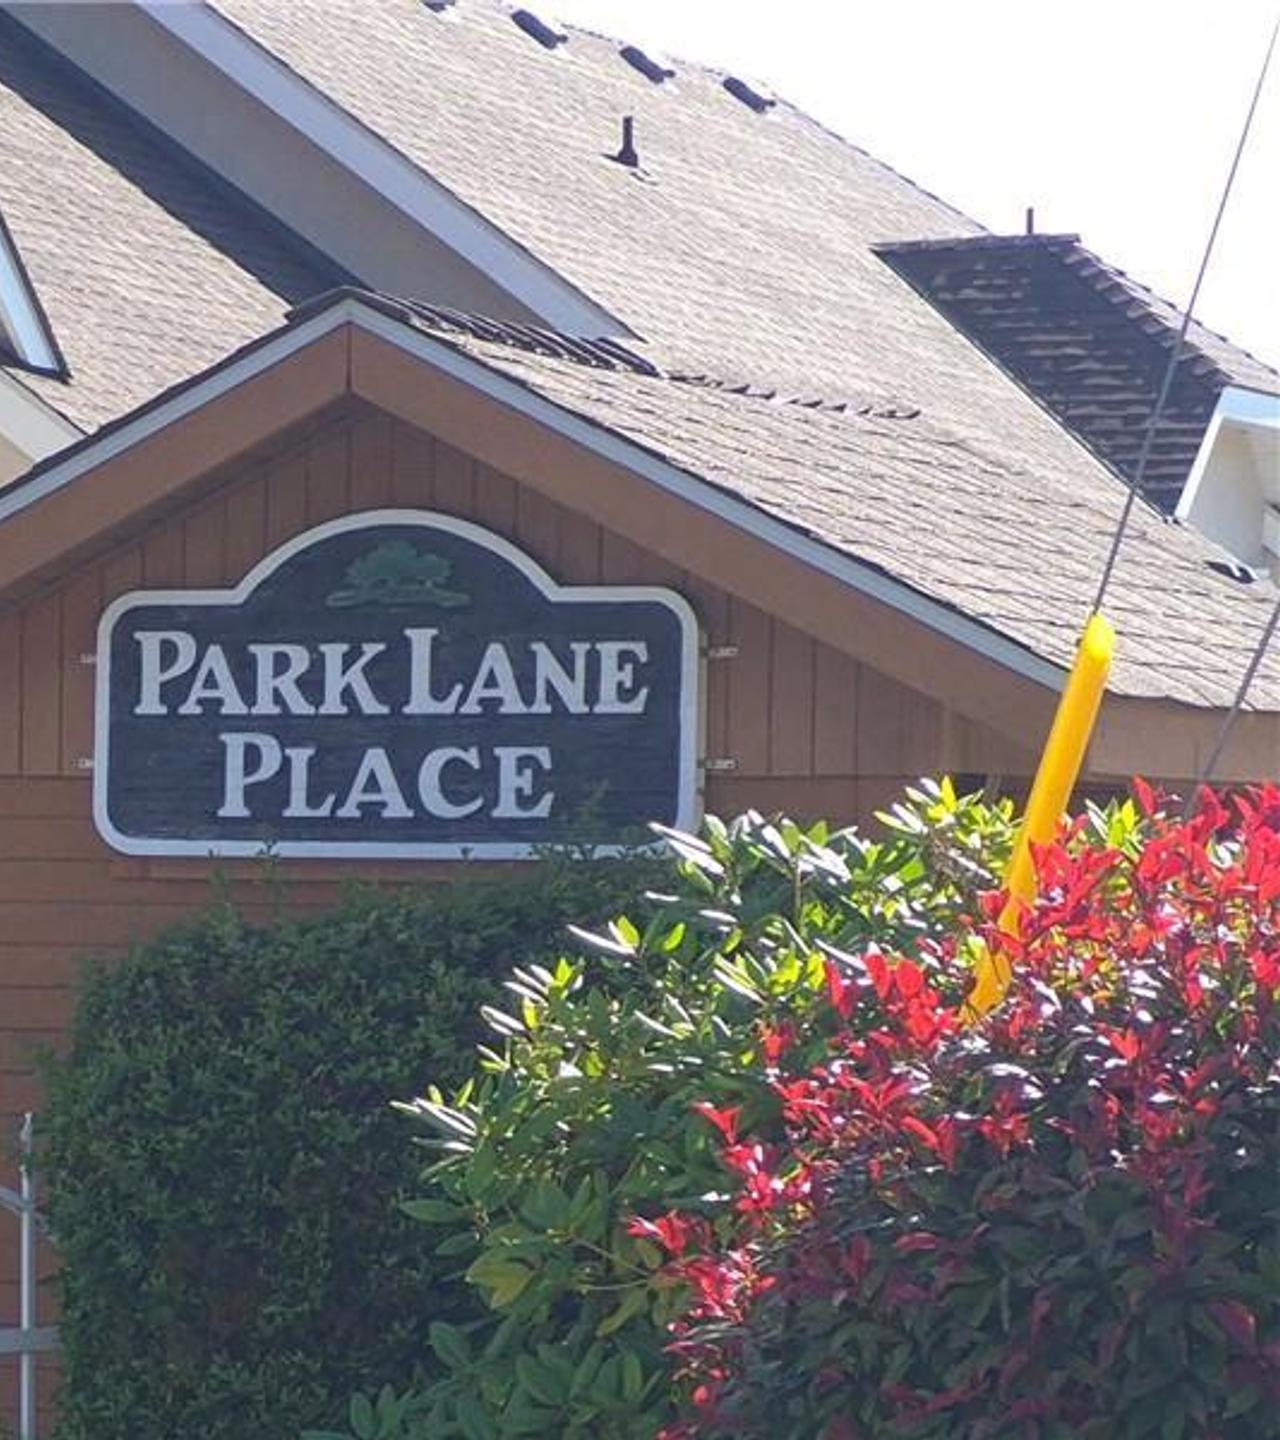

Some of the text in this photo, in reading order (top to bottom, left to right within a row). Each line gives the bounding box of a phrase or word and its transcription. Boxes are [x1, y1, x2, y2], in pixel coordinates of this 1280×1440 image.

[133, 627, 649, 715] PARK LANE
[217, 732, 555, 818] PLACE
